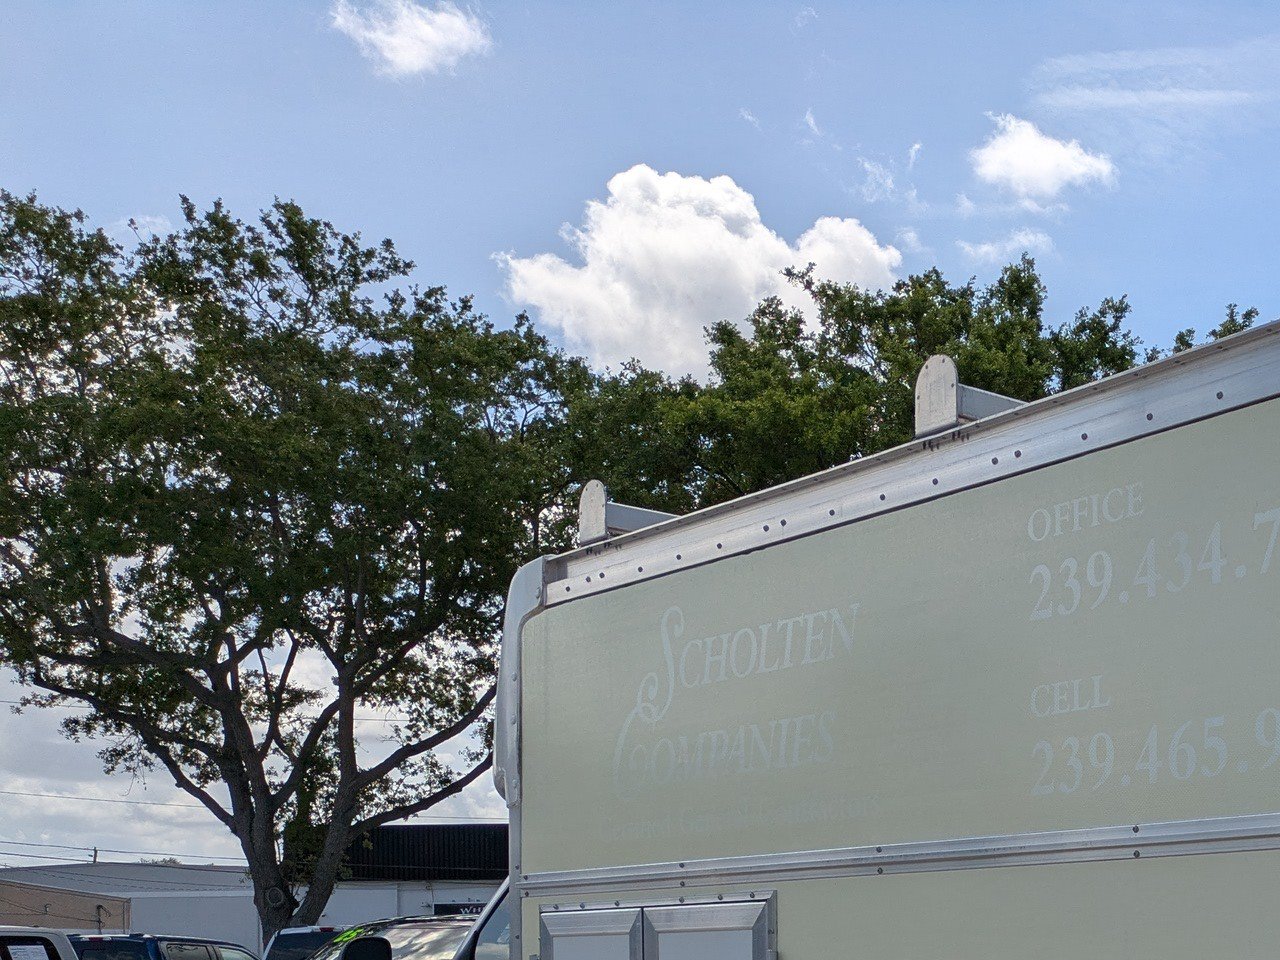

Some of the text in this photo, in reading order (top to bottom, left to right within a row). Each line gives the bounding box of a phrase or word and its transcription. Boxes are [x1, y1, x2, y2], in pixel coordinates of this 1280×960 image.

[1027, 482, 1144, 542] OFFICE
[637, 604, 863, 723] SCHOLTEN
[1029, 675, 1112, 718] CELL
